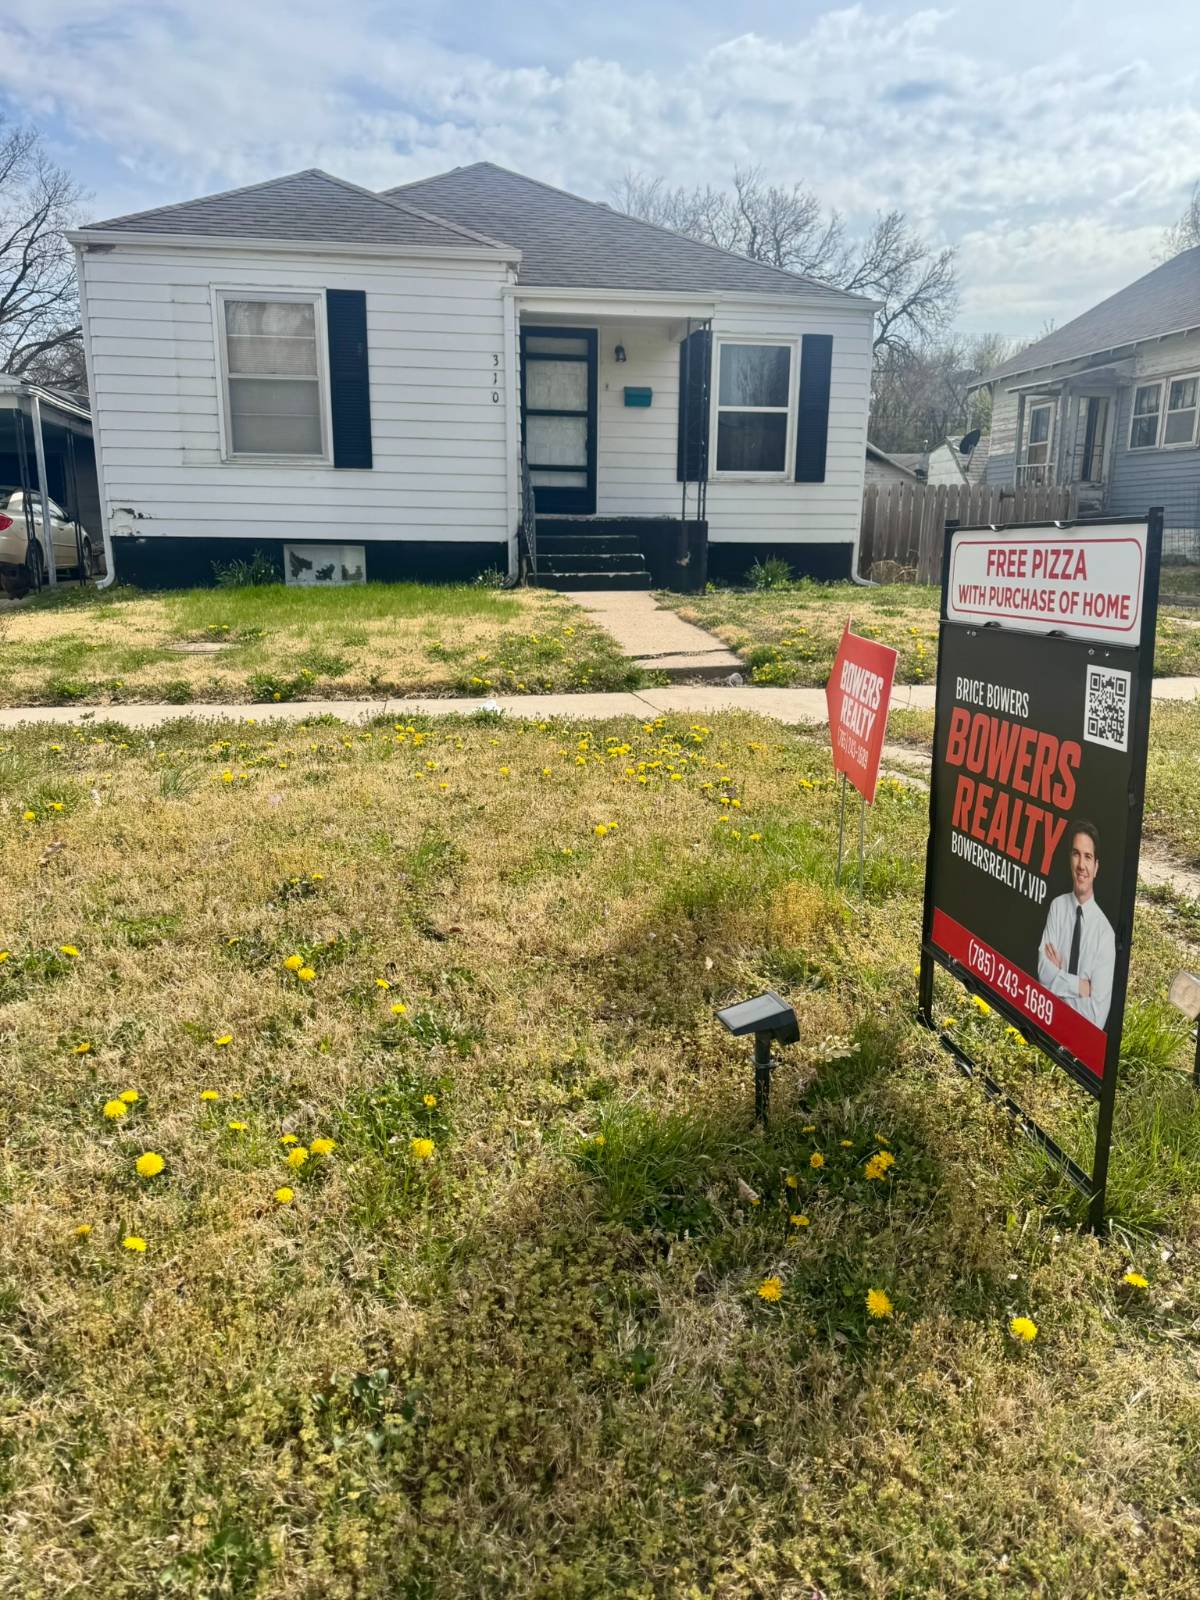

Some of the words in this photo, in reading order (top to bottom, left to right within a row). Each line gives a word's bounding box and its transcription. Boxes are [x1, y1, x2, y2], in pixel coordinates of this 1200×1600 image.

[986, 549, 1028, 578] FREE
[1031, 549, 1088, 581] PIZZA
[958, 584, 986, 606] WITH
[990, 586, 1056, 612] PURCHASE
[1059, 591, 1080, 614] OF
[1082, 593, 1131, 620] HOME
[839, 659, 884, 711] BOWERS
[956, 677, 985, 706] BRICE
[986, 683, 1030, 718] BOWERS
[840, 694, 876, 742] REALTY
[945, 706, 1082, 811] BOWERS
[951, 774, 1069, 876] REALTY
[951, 831, 1047, 905] BOWERSREALTY.VIP
[968, 938, 997, 982] (785)
[997, 963, 1054, 1025] 243-1689
